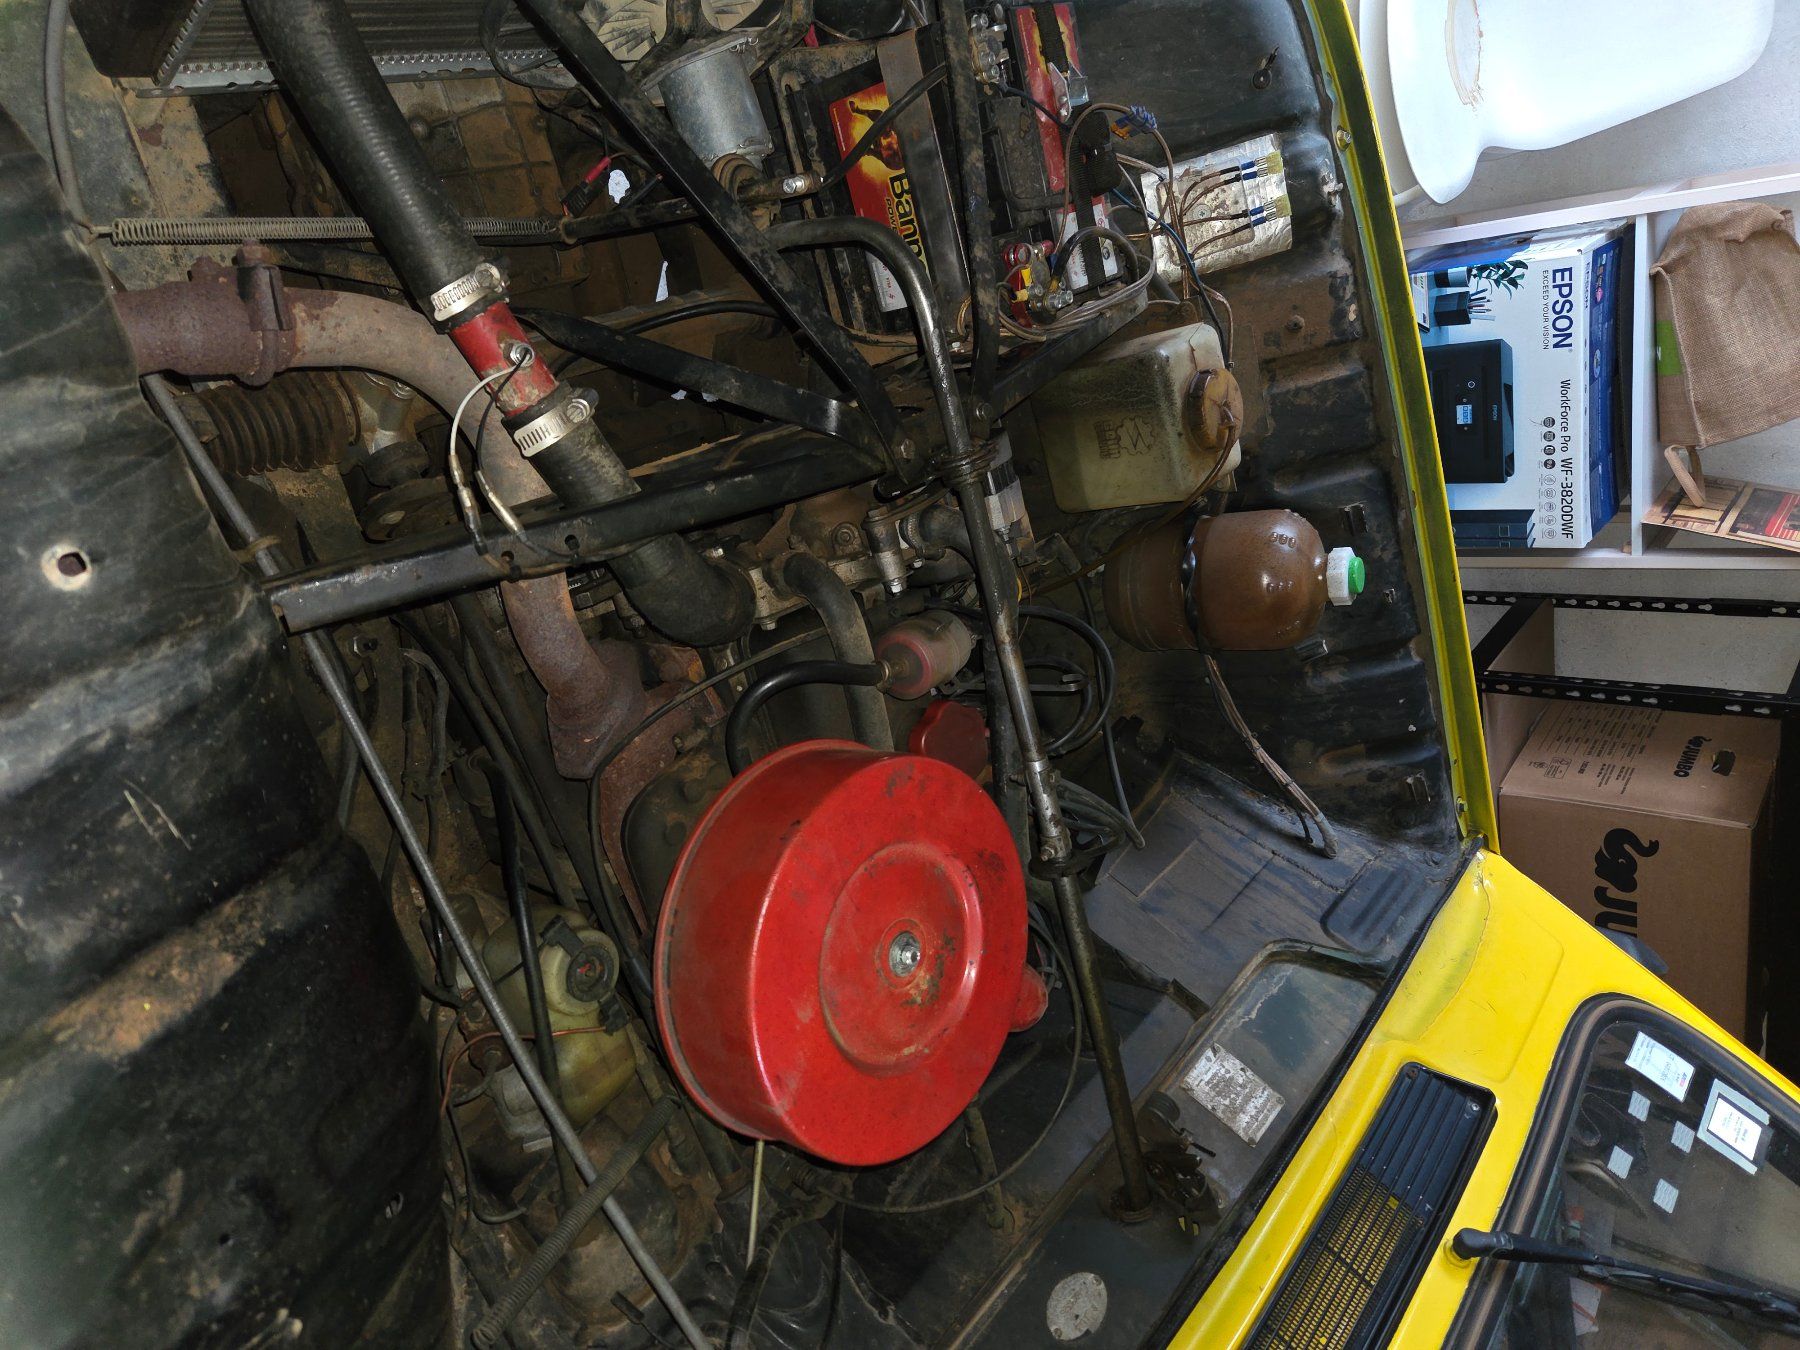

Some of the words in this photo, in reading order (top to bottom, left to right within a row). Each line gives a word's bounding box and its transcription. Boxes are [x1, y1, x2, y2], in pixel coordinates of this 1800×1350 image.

[886, 198, 898, 231] POWE
[889, 173, 922, 258] Bann
[1551, 267, 1573, 349] EPSON
[1560, 379, 1571, 432] WorkForce
[1560, 435, 1571, 453] Pro
[1561, 457, 1574, 539] WF-3820DWF
[1673, 745, 1701, 778] JUMBO
